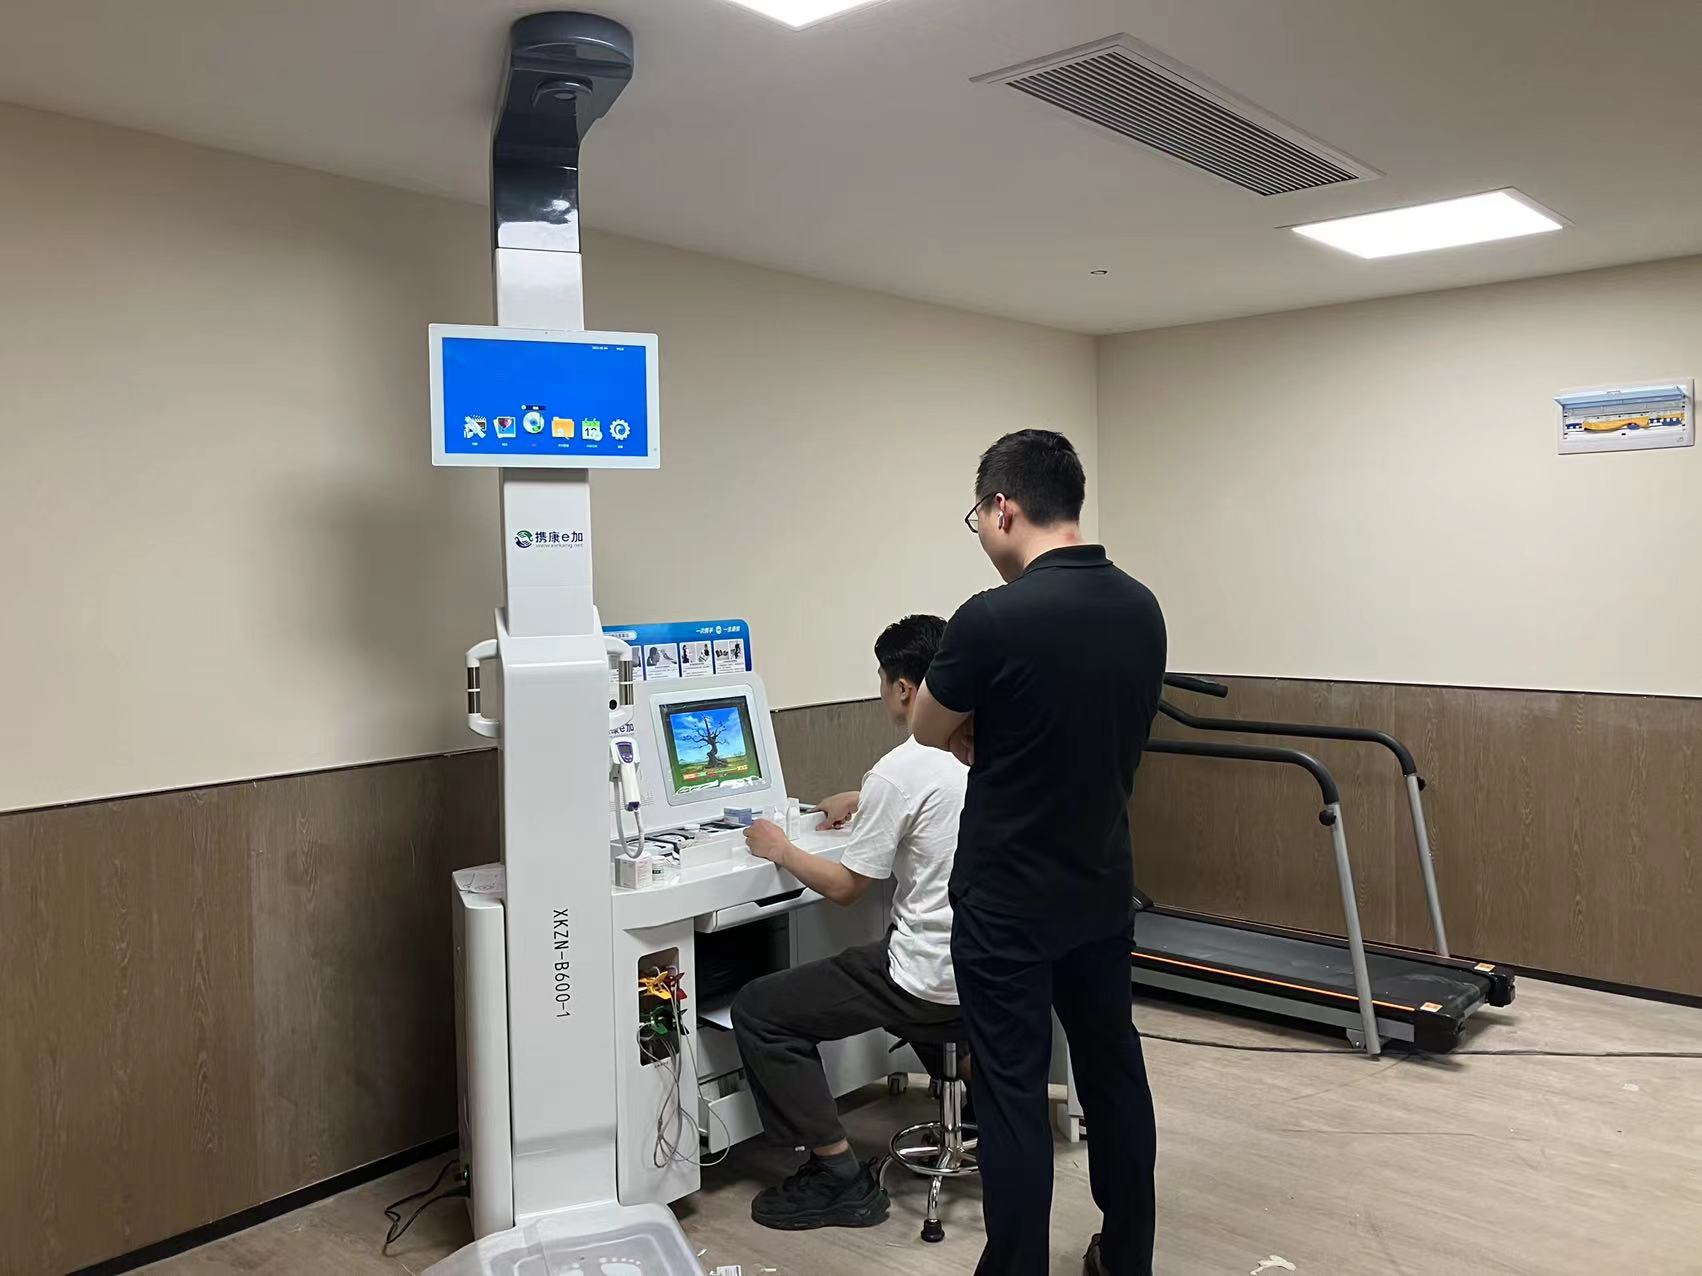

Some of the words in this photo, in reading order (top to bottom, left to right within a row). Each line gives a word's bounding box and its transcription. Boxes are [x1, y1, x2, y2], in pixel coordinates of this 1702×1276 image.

[535, 531, 583, 543] 携康e加
[553, 908, 572, 1018] XKZN-B600-1
